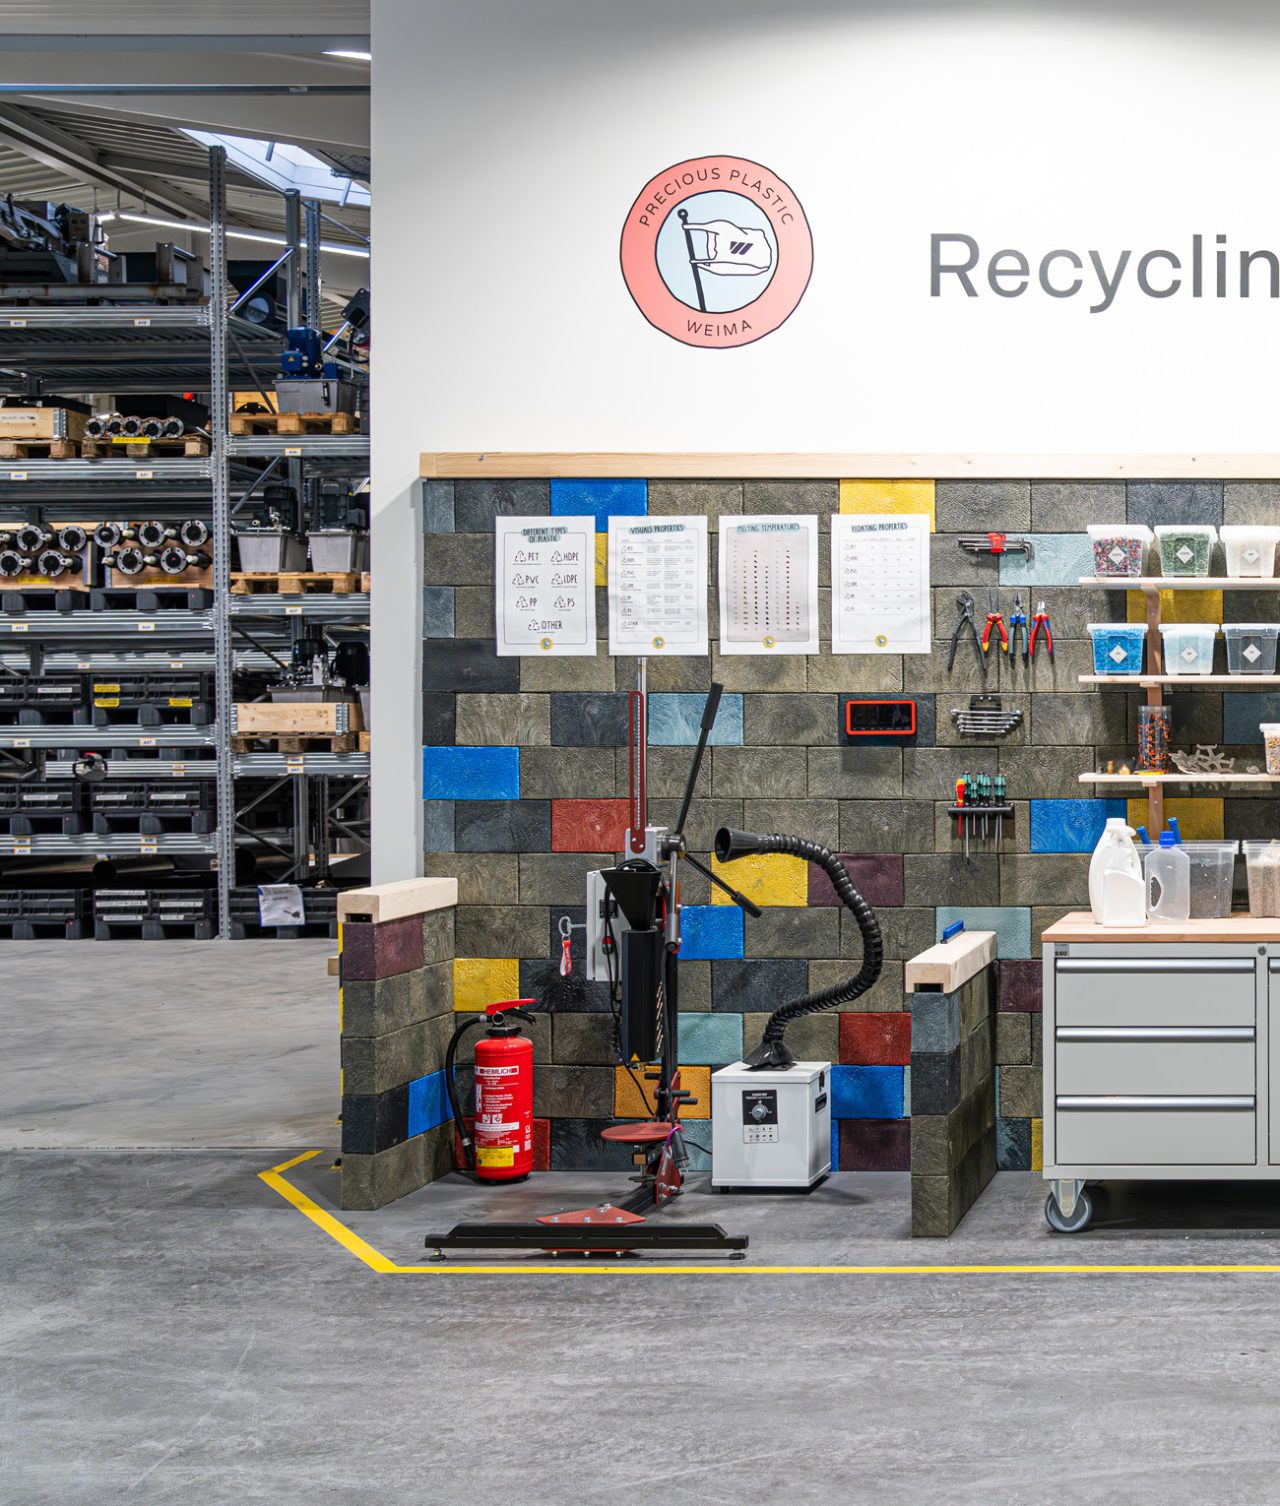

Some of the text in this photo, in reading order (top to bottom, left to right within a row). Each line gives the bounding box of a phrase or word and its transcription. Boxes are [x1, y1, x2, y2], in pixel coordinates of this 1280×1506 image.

[639, 167, 794, 227] PRECIOUS PLASTIC
[687, 319, 752, 337] WEIMA
[523, 526, 567, 536] DIFFERENT TYPES
[630, 524, 684, 534] VISUALS PROPERTIES
[736, 522, 800, 533] MELTING TEMPERATURES
[851, 522, 908, 533] FLOATING PROPERTIES
[528, 552, 540, 561] PET
[563, 552, 579, 561] HDPE
[525, 575, 540, 584] PVC
[563, 574, 578, 584] LDPE
[529, 597, 538, 607] PP
[566, 597, 576, 607] PS
[541, 620, 563, 630] OTHER
